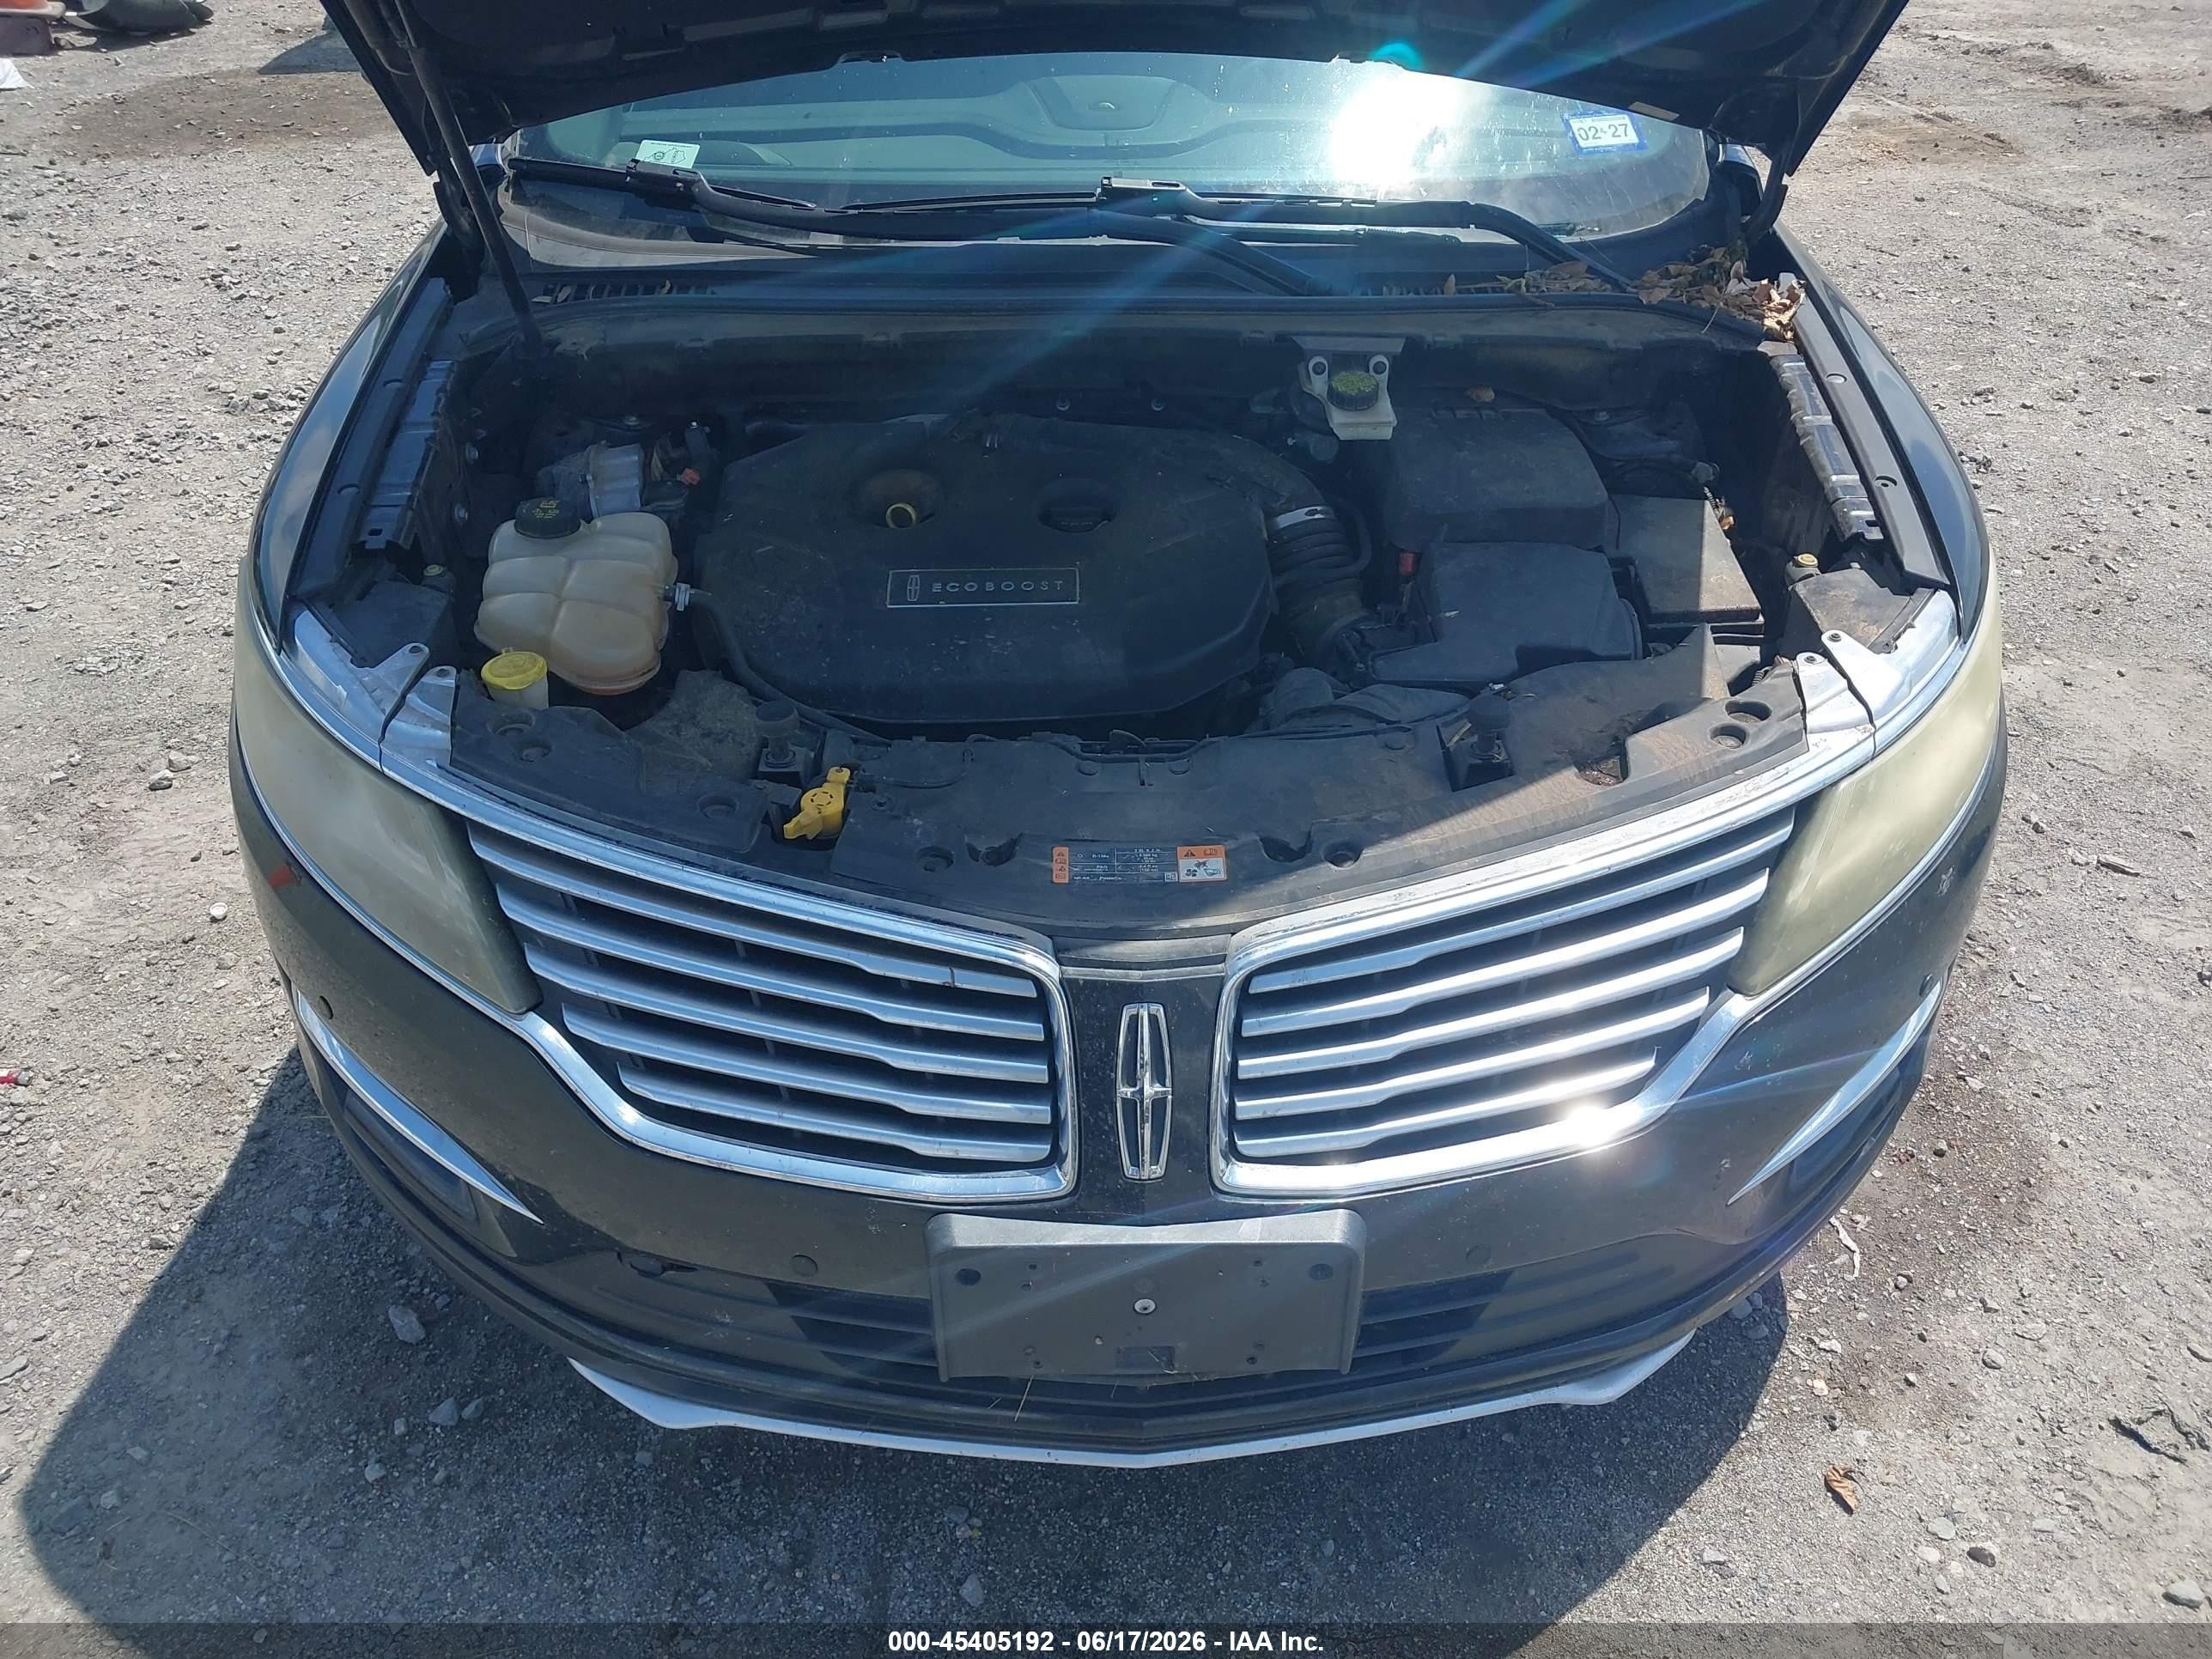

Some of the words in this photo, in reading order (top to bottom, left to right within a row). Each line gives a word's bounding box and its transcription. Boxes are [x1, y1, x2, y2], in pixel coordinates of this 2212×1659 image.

[1577, 125, 1601, 141] 02
[1607, 123, 1628, 138] 27
[931, 580, 1064, 592] ECOBOOST
